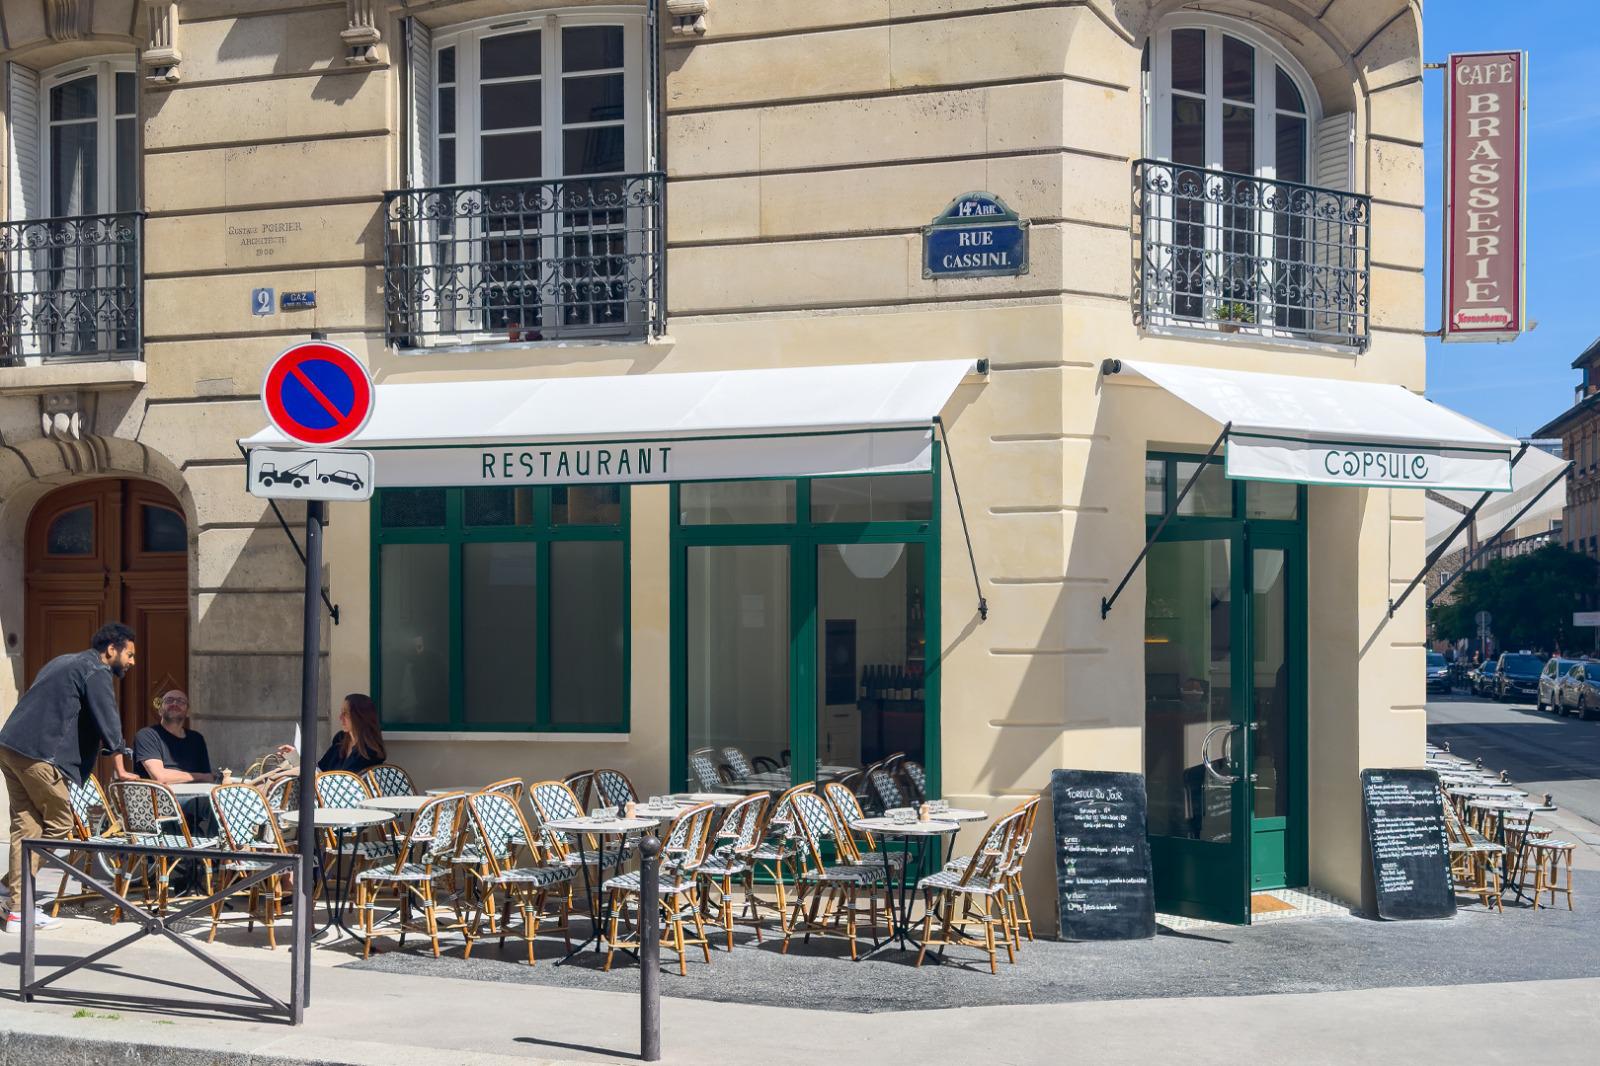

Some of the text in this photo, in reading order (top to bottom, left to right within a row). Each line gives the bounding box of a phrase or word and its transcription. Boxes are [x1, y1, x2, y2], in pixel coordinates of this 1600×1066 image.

[1466, 92, 1501, 303] BRASSERIE
[958, 231, 993, 247] RUE
[257, 290, 270, 313] 2
[290, 292, 307, 302] GAZ
[482, 447, 671, 478] RESTAURANT
